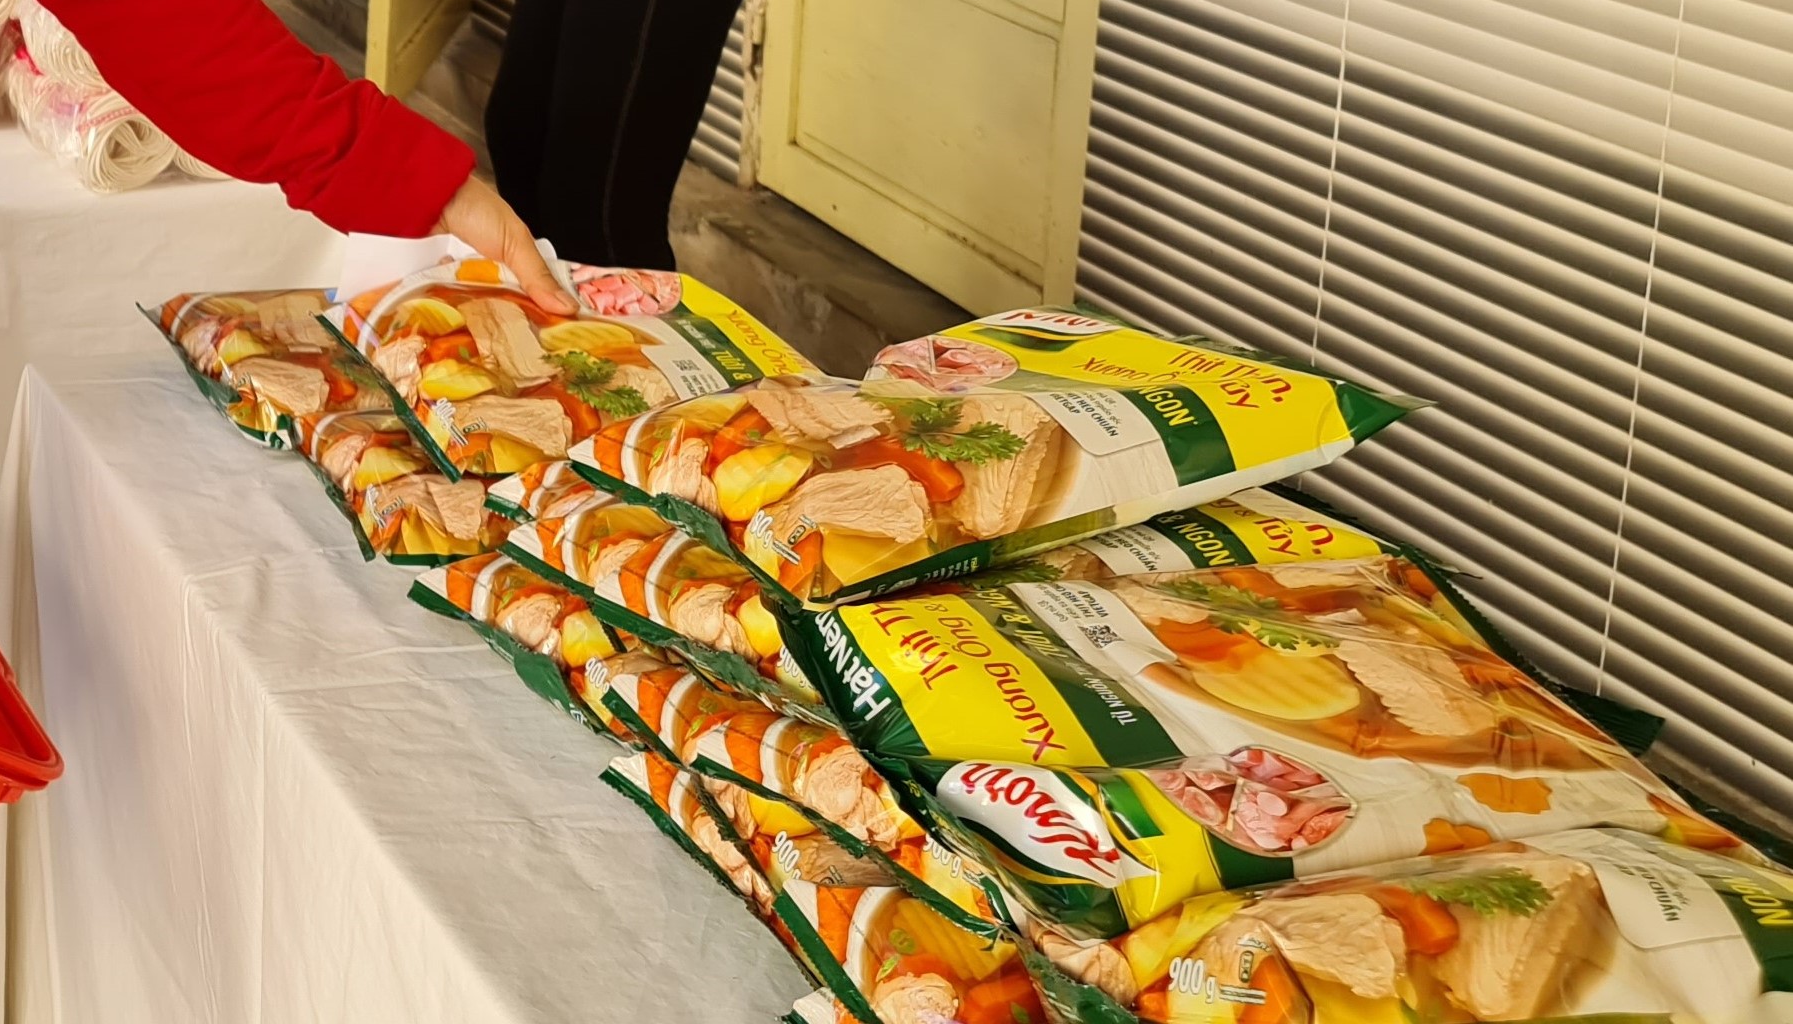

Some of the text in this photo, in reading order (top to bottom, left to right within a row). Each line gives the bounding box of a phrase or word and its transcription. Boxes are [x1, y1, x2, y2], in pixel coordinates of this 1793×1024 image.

[937, 616, 992, 659] Ống
[841, 655, 892, 722] Hạt
[983, 662, 1067, 763] Xương
[961, 763, 1120, 879] Knorr
[771, 830, 800, 873] 900
[1168, 956, 1205, 995] 900
